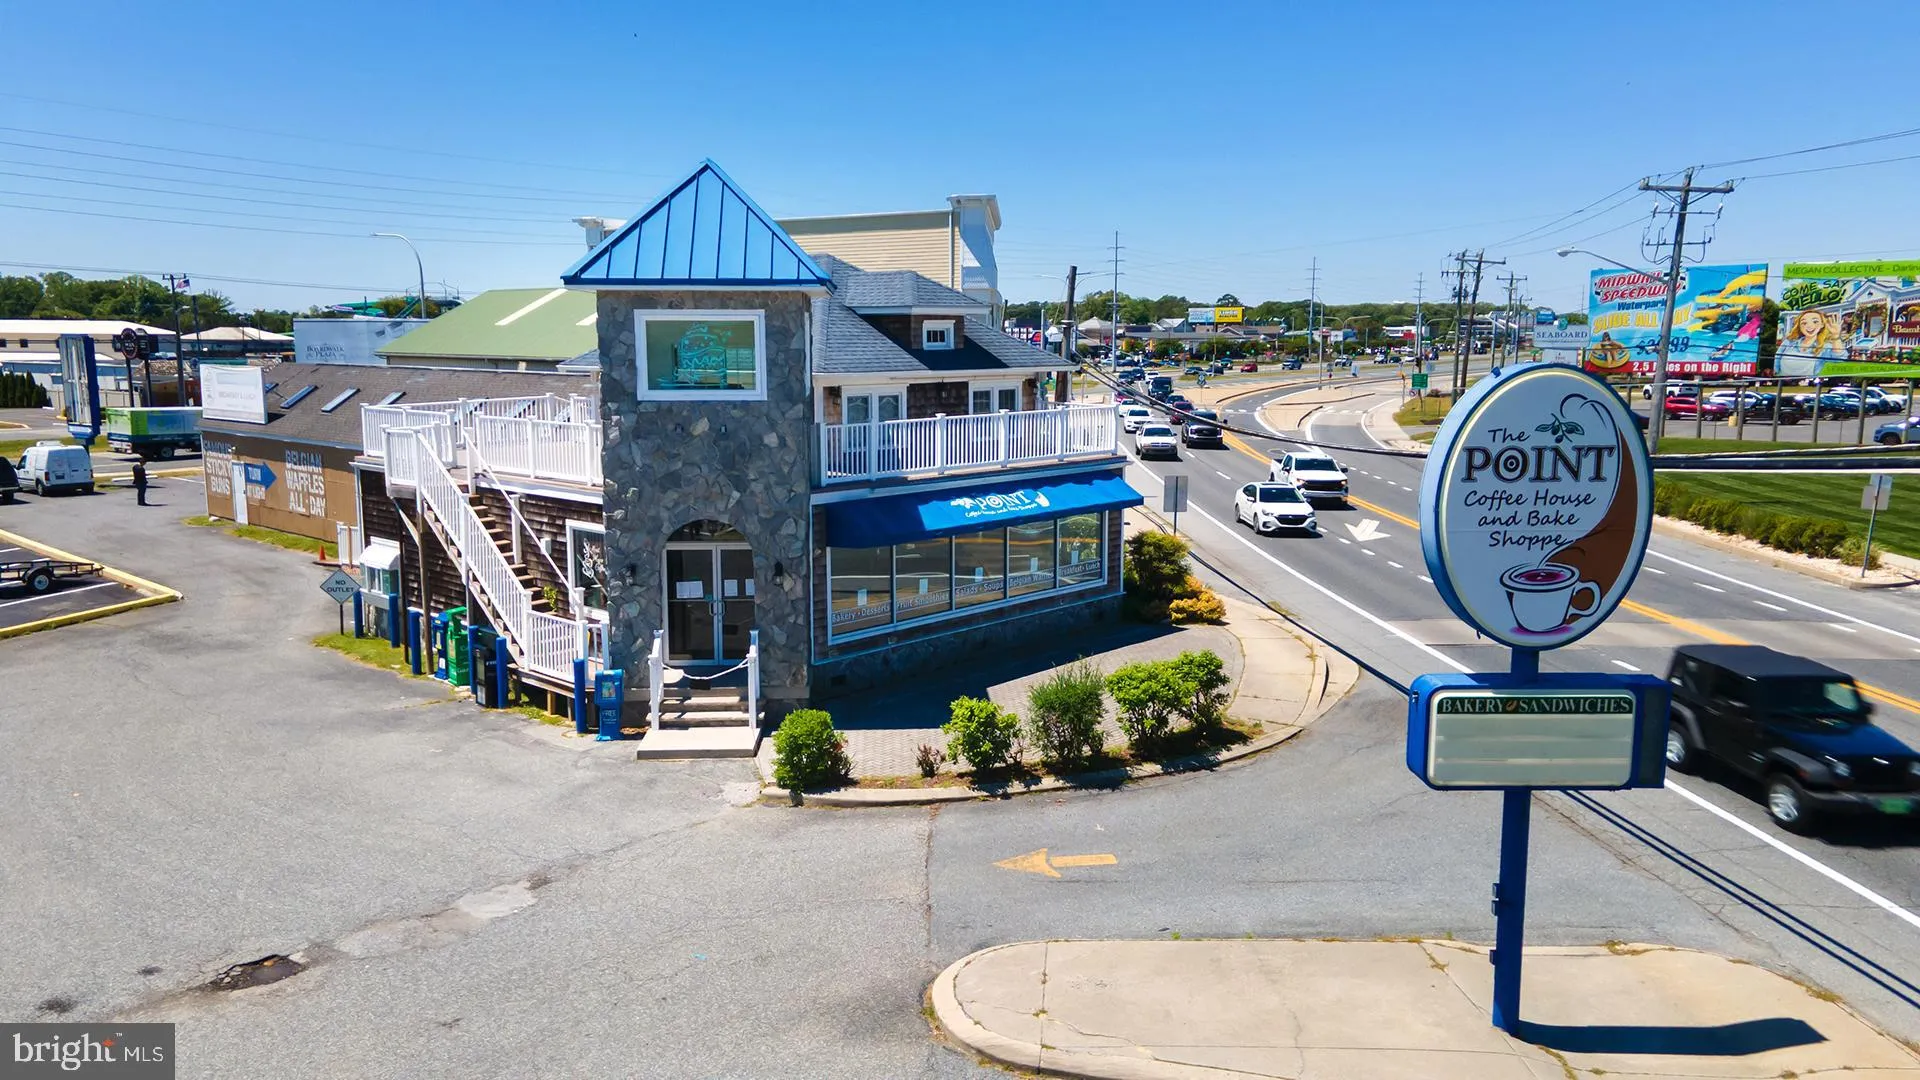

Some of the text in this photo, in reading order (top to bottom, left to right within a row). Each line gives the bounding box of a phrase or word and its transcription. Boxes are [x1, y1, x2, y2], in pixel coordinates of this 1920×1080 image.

[1786, 265, 1822, 275] MEGAN
[1823, 264, 1885, 274] COLLECTIVE
[1892, 263, 1920, 273] Darlin
[1782, 279, 1851, 301] COME SAY
[1787, 288, 1847, 310] HELLO!
[1592, 312, 1631, 334] SLIDE
[1635, 311, 1659, 328] ALL
[1536, 331, 1588, 339] SEABOARD
[1632, 363, 1650, 373] 2.5
[1684, 364, 1698, 373] on
[1701, 363, 1721, 373] the
[1722, 362, 1752, 374] Right
[1488, 427, 1531, 443] The
[206, 457, 233, 479] STICKY
[285, 449, 323, 474] BELGIAN
[1461, 445, 1617, 483] POINT
[285, 469, 325, 496] WAFFLES
[288, 491, 326, 518] ALL DAY
[975, 490, 1032, 510] POINT
[1464, 489, 1597, 511] Coffee House
[1478, 509, 1580, 527] and Bake
[1488, 531, 1571, 551] Shoppe
[861, 603, 891, 617] Desserts
[1441, 698, 1631, 713] BAKERY SANDWICHES
